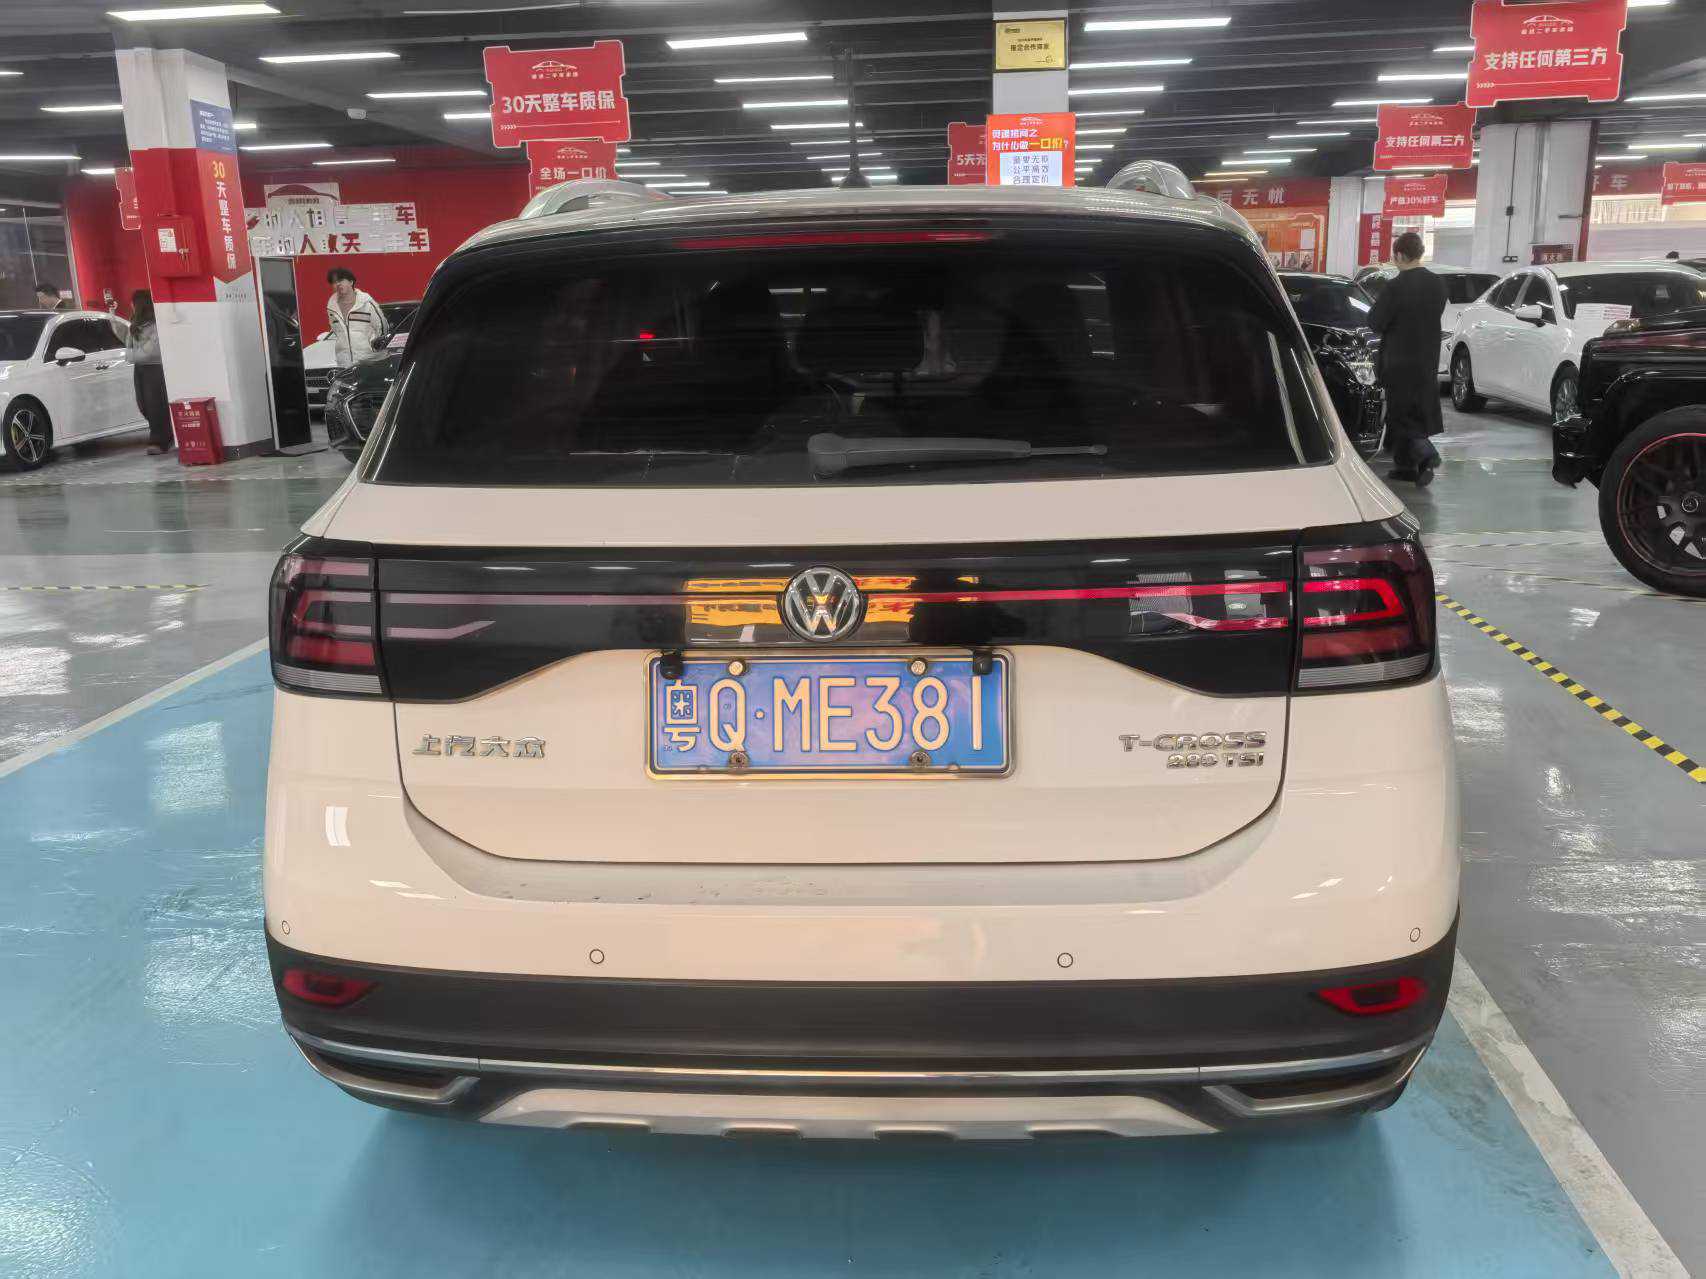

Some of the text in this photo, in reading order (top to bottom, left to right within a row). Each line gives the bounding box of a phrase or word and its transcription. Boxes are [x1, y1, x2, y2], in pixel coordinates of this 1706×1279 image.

[1484, 47, 1608, 71] 支持任何第三方
[501, 90, 616, 114] 30天整车质保
[1385, 134, 1465, 148] 支持任何第三方
[540, 167, 607, 180] 全场一口价
[212, 162, 236, 269] 30天整车质保
[664, 677, 983, 752] 粤Q·ME381
[412, 734, 546, 757] 上汽大众
[1119, 731, 1267, 752] T-CROSS
[1224, 752, 1264, 768] TSI
